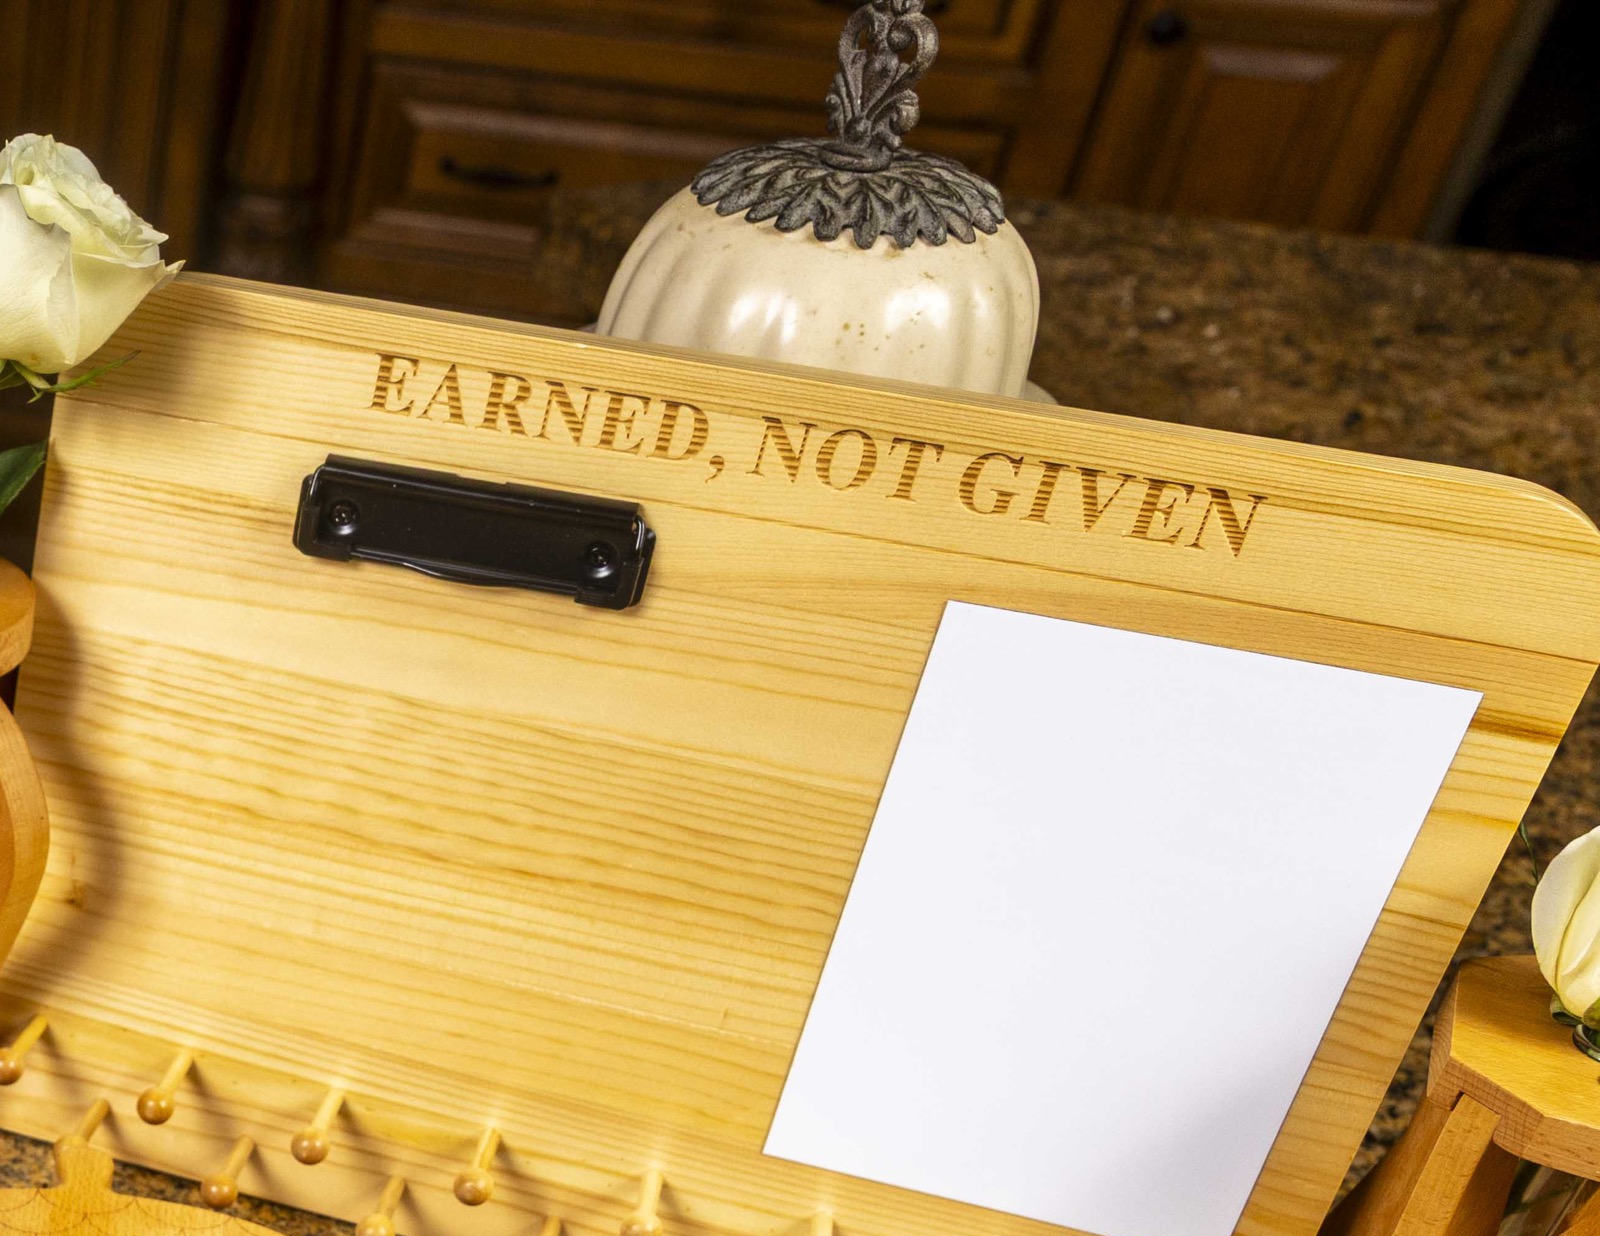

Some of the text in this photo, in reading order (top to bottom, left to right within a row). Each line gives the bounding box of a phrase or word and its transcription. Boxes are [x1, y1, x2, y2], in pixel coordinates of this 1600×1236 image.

[366, 352, 1269, 558] EARNED, NOT GIVEN
